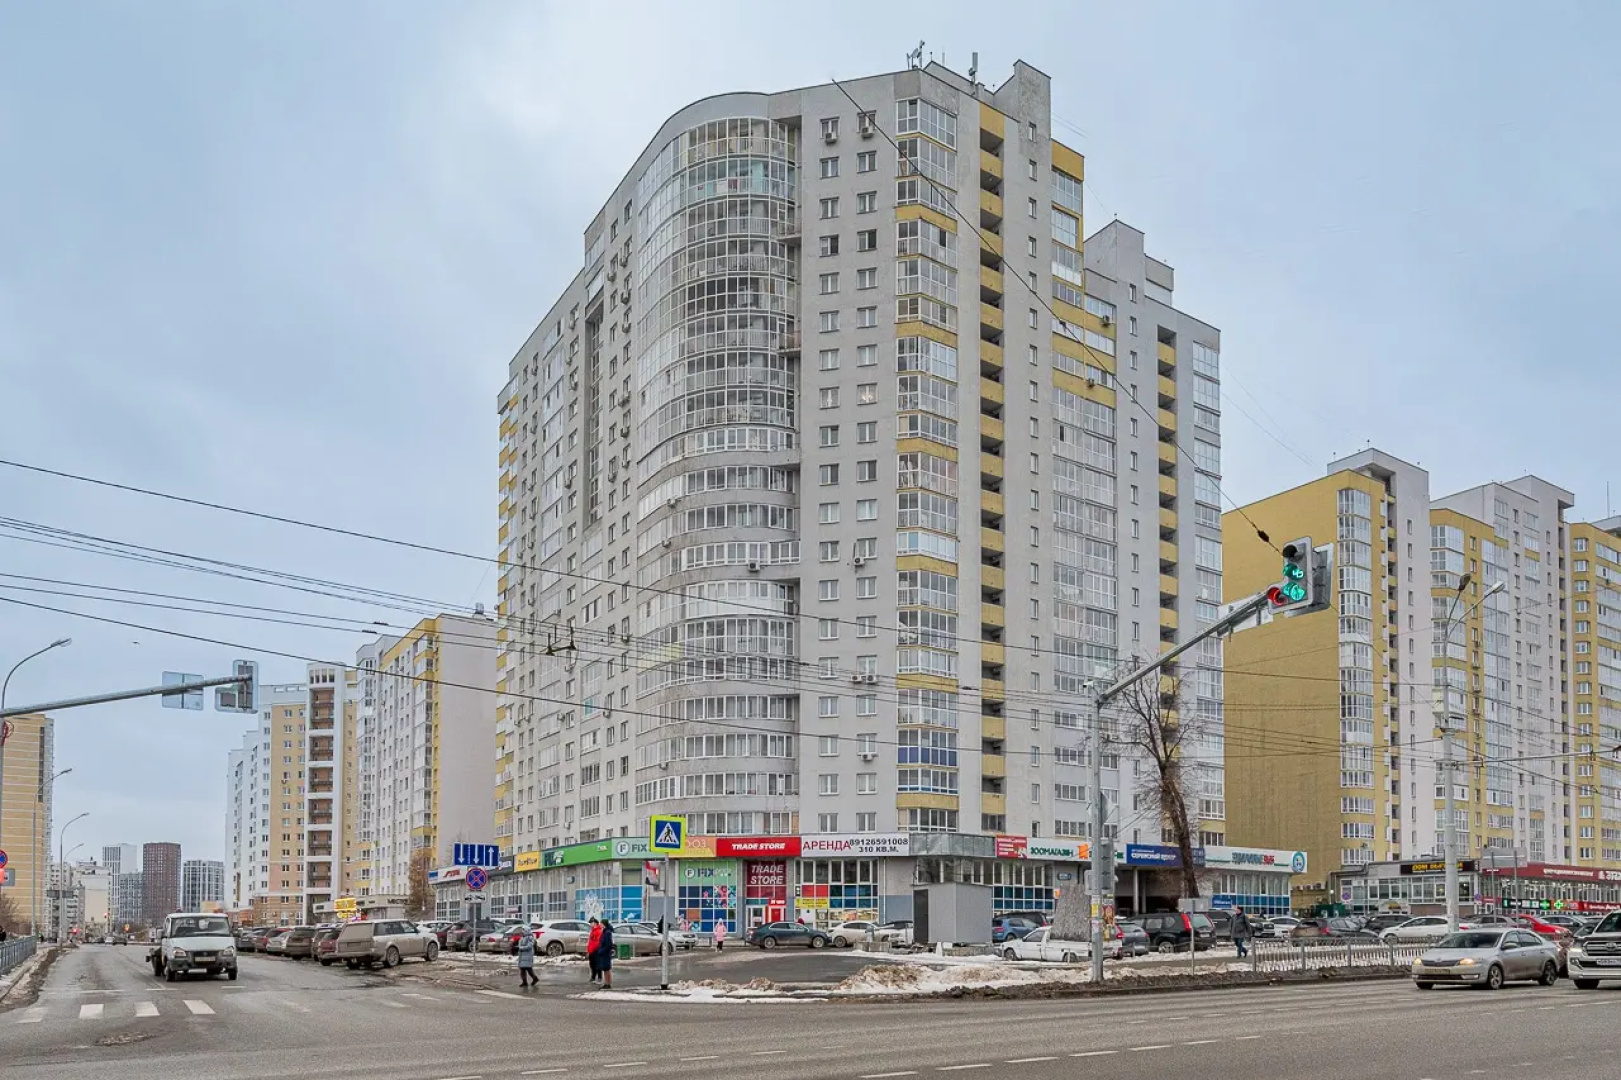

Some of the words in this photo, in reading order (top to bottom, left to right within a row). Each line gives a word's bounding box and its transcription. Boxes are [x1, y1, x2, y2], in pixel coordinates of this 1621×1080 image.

[631, 843, 647, 852] FIX
[803, 840, 851, 851] АРЕНДА
[850, 838, 908, 846] 89126591008
[1030, 846, 1073, 856] ЗООМАГАЗИН
[751, 864, 784, 873] TRADE
[751, 876, 784, 885] STORE
